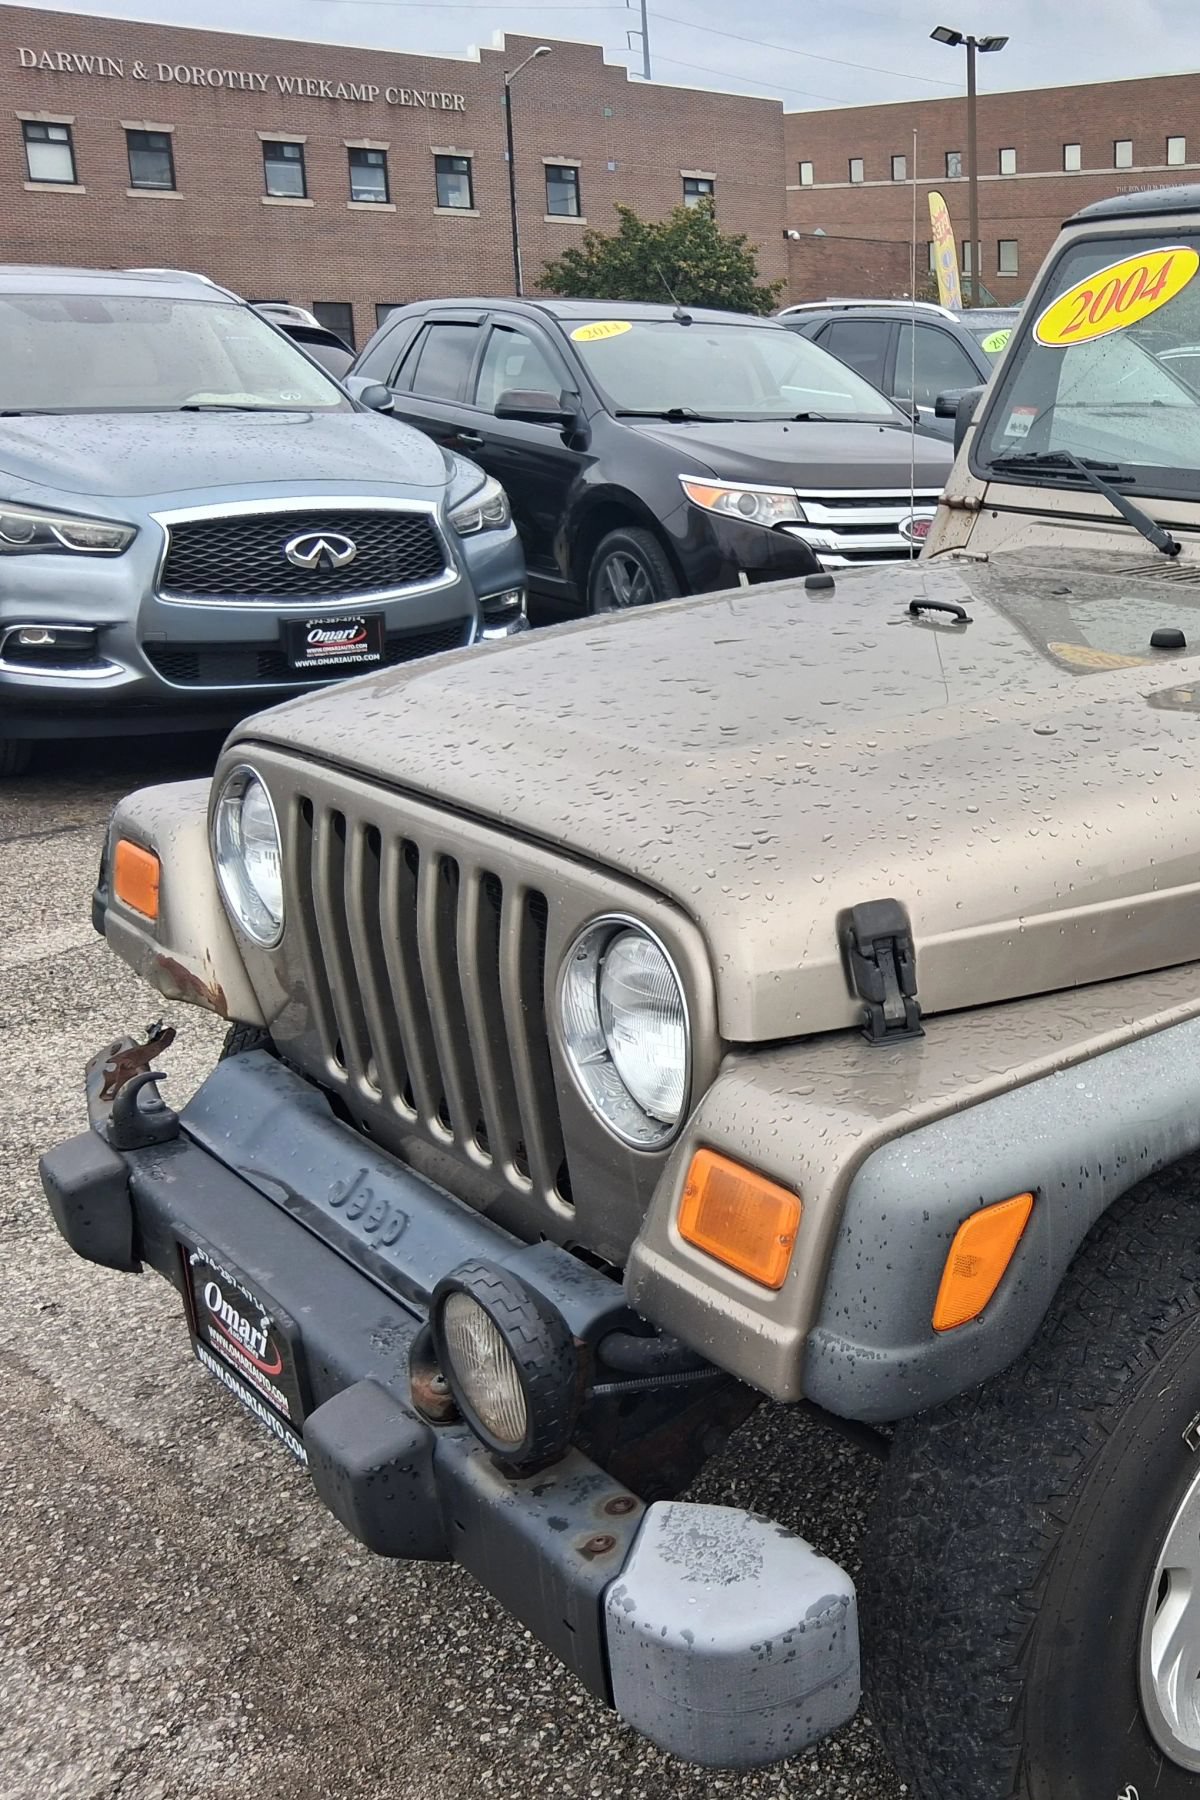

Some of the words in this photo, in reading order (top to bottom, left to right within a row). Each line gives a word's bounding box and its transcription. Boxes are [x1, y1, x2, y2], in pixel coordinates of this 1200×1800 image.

[18, 47, 124, 79] DARWIN
[132, 60, 148, 80] &
[157, 63, 270, 92] DOROTHY
[275, 76, 380, 103] WIEKAMP
[385, 87, 466, 112] CENTER
[1059, 254, 1176, 338] 2004
[990, 332, 1008, 349] 201
[295, 653, 380, 668] WWW.OMARIAUTO.COM
[307, 625, 359, 643] Omari
[328, 1167, 412, 1250] Jeep
[204, 1282, 269, 1358] Omari
[197, 1344, 309, 1465] WWW.OMARIAUTO.COM
[208, 1324, 289, 1410] WWW.OMARIAUTO.COM
